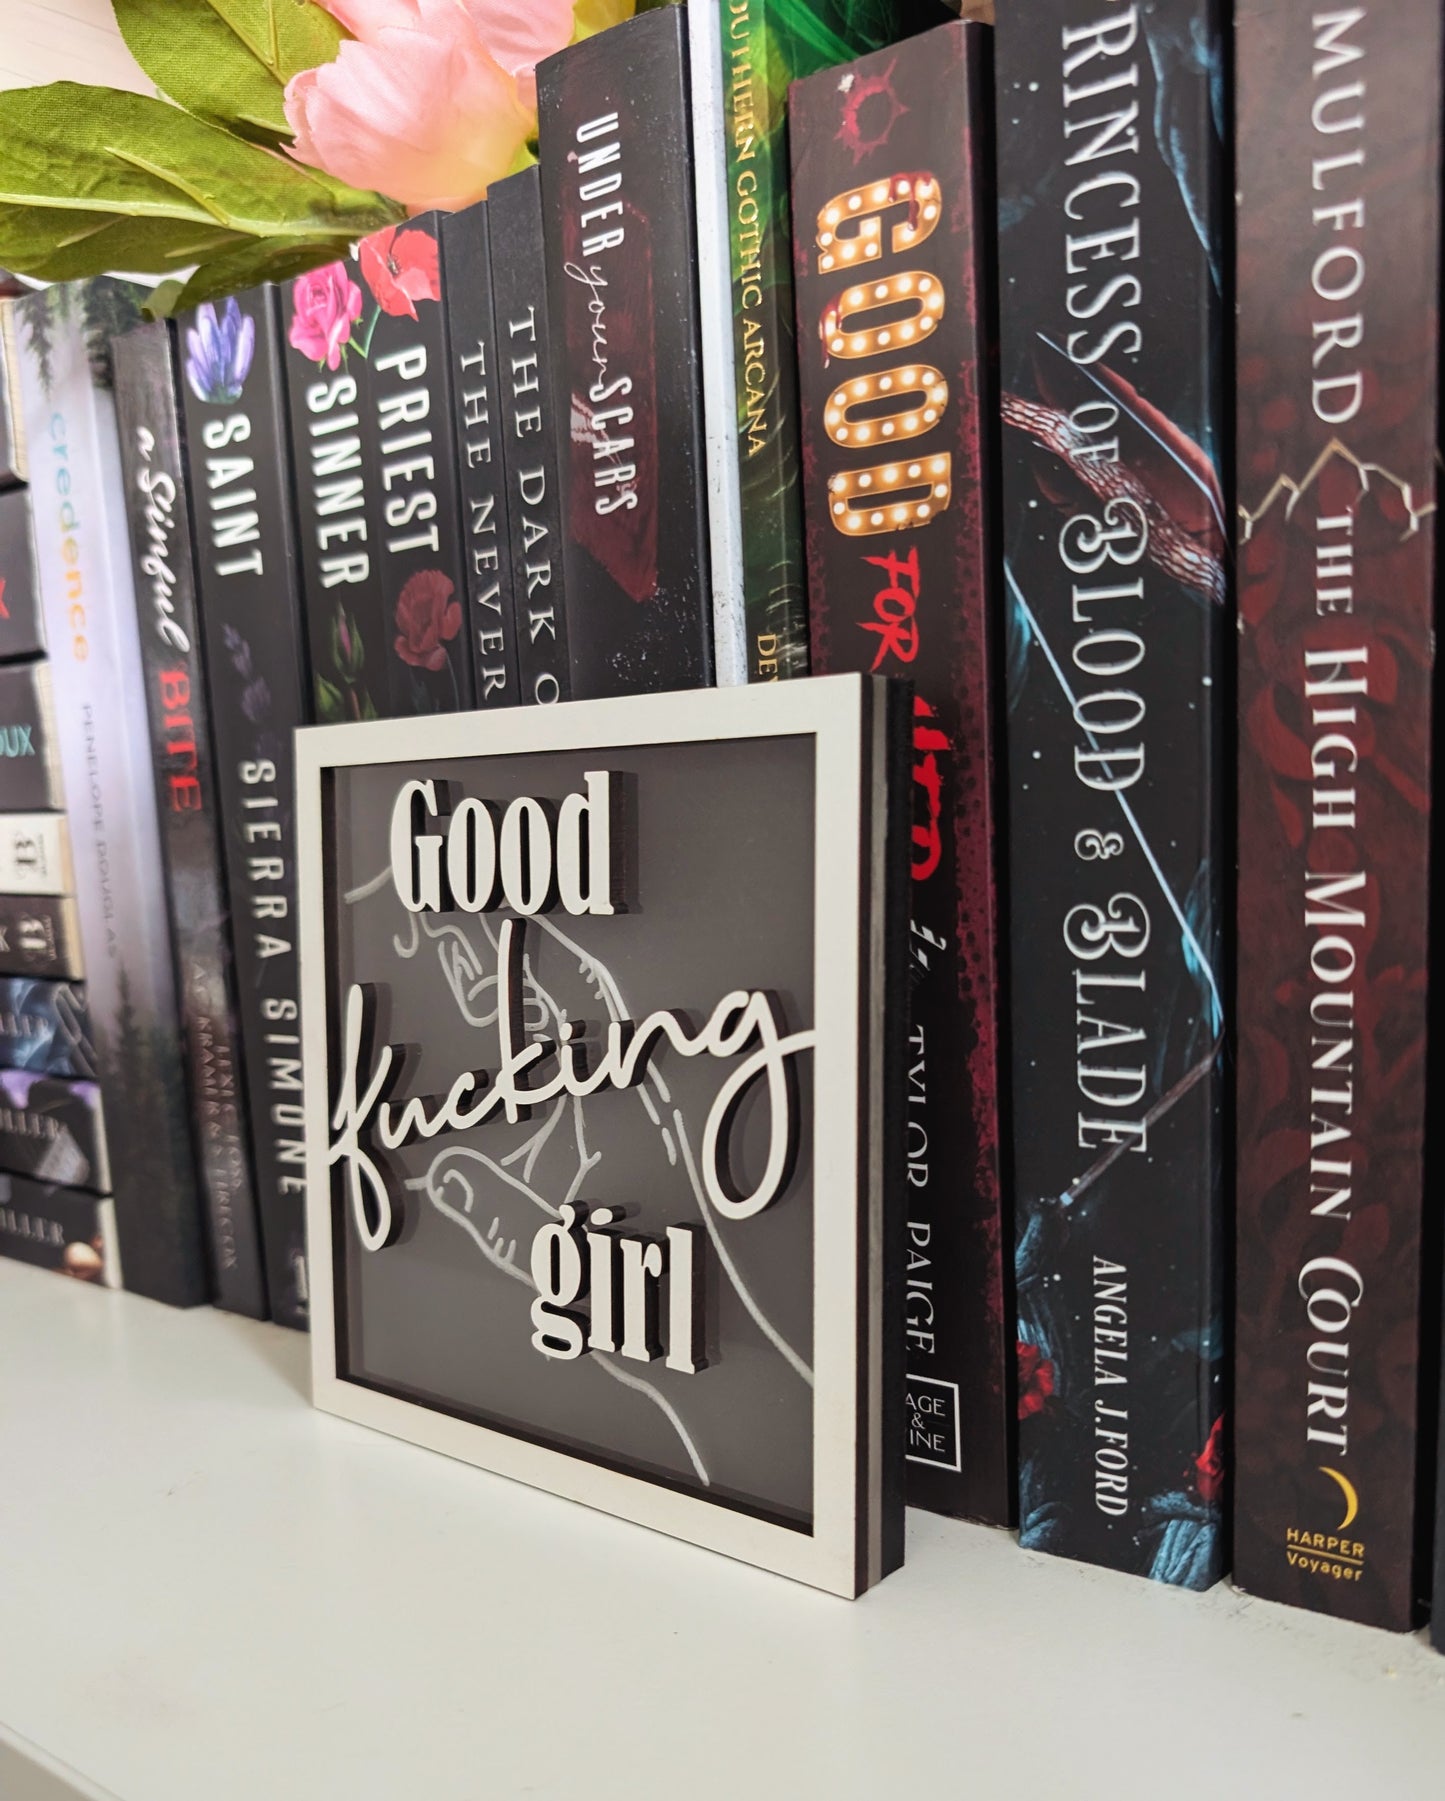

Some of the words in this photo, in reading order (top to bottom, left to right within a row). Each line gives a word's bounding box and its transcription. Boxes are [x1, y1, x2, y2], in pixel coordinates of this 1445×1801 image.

[730, 0, 755, 162] OUTHERN
[576, 112, 625, 257] UNDER
[736, 170, 764, 310] GOTHIC
[1062, 2, 1143, 365] RINCESS
[1311, 6, 1366, 426] MULFORD
[508, 305, 541, 439] THE
[564, 261, 608, 387] your
[742, 317, 768, 457] ARCANA
[815, 169, 952, 538] GOOD
[137, 426, 155, 461] a
[374, 343, 439, 554] PRIEST
[460, 341, 491, 469] THE
[589, 375, 638, 517] SCARS
[1068, 400, 1120, 464] OF
[50, 411, 89, 663] credence
[203, 413, 263, 576] SAINT
[305, 374, 370, 589] SINNER
[138, 470, 190, 652] Sinful
[470, 498, 507, 699] NEVER
[519, 466, 556, 645] DARK
[856, 544, 921, 673] FOR
[1316, 505, 1354, 617] THE
[1059, 497, 1149, 792] BLOOD
[158, 667, 202, 812] BITE
[1304, 646, 1368, 830] HIGH
[239, 759, 292, 959] SIERRA
[390, 770, 616, 917] Good
[1074, 829, 1125, 861] &
[329, 918, 817, 1252] fucking
[1063, 891, 1151, 1153] BLADE
[1304, 870, 1367, 1221] MOUNTAIN
[530, 1203, 697, 1375] girl
[1093, 1255, 1128, 1387] ANGELA
[1298, 1256, 1364, 1457] COURT
[905, 1392, 946, 1417] AGE
[910, 1428, 945, 1453] INE
[911, 1412, 926, 1430] &
[1286, 1551, 1363, 1582] Voyager
[1287, 1527, 1365, 1558] HARPER
